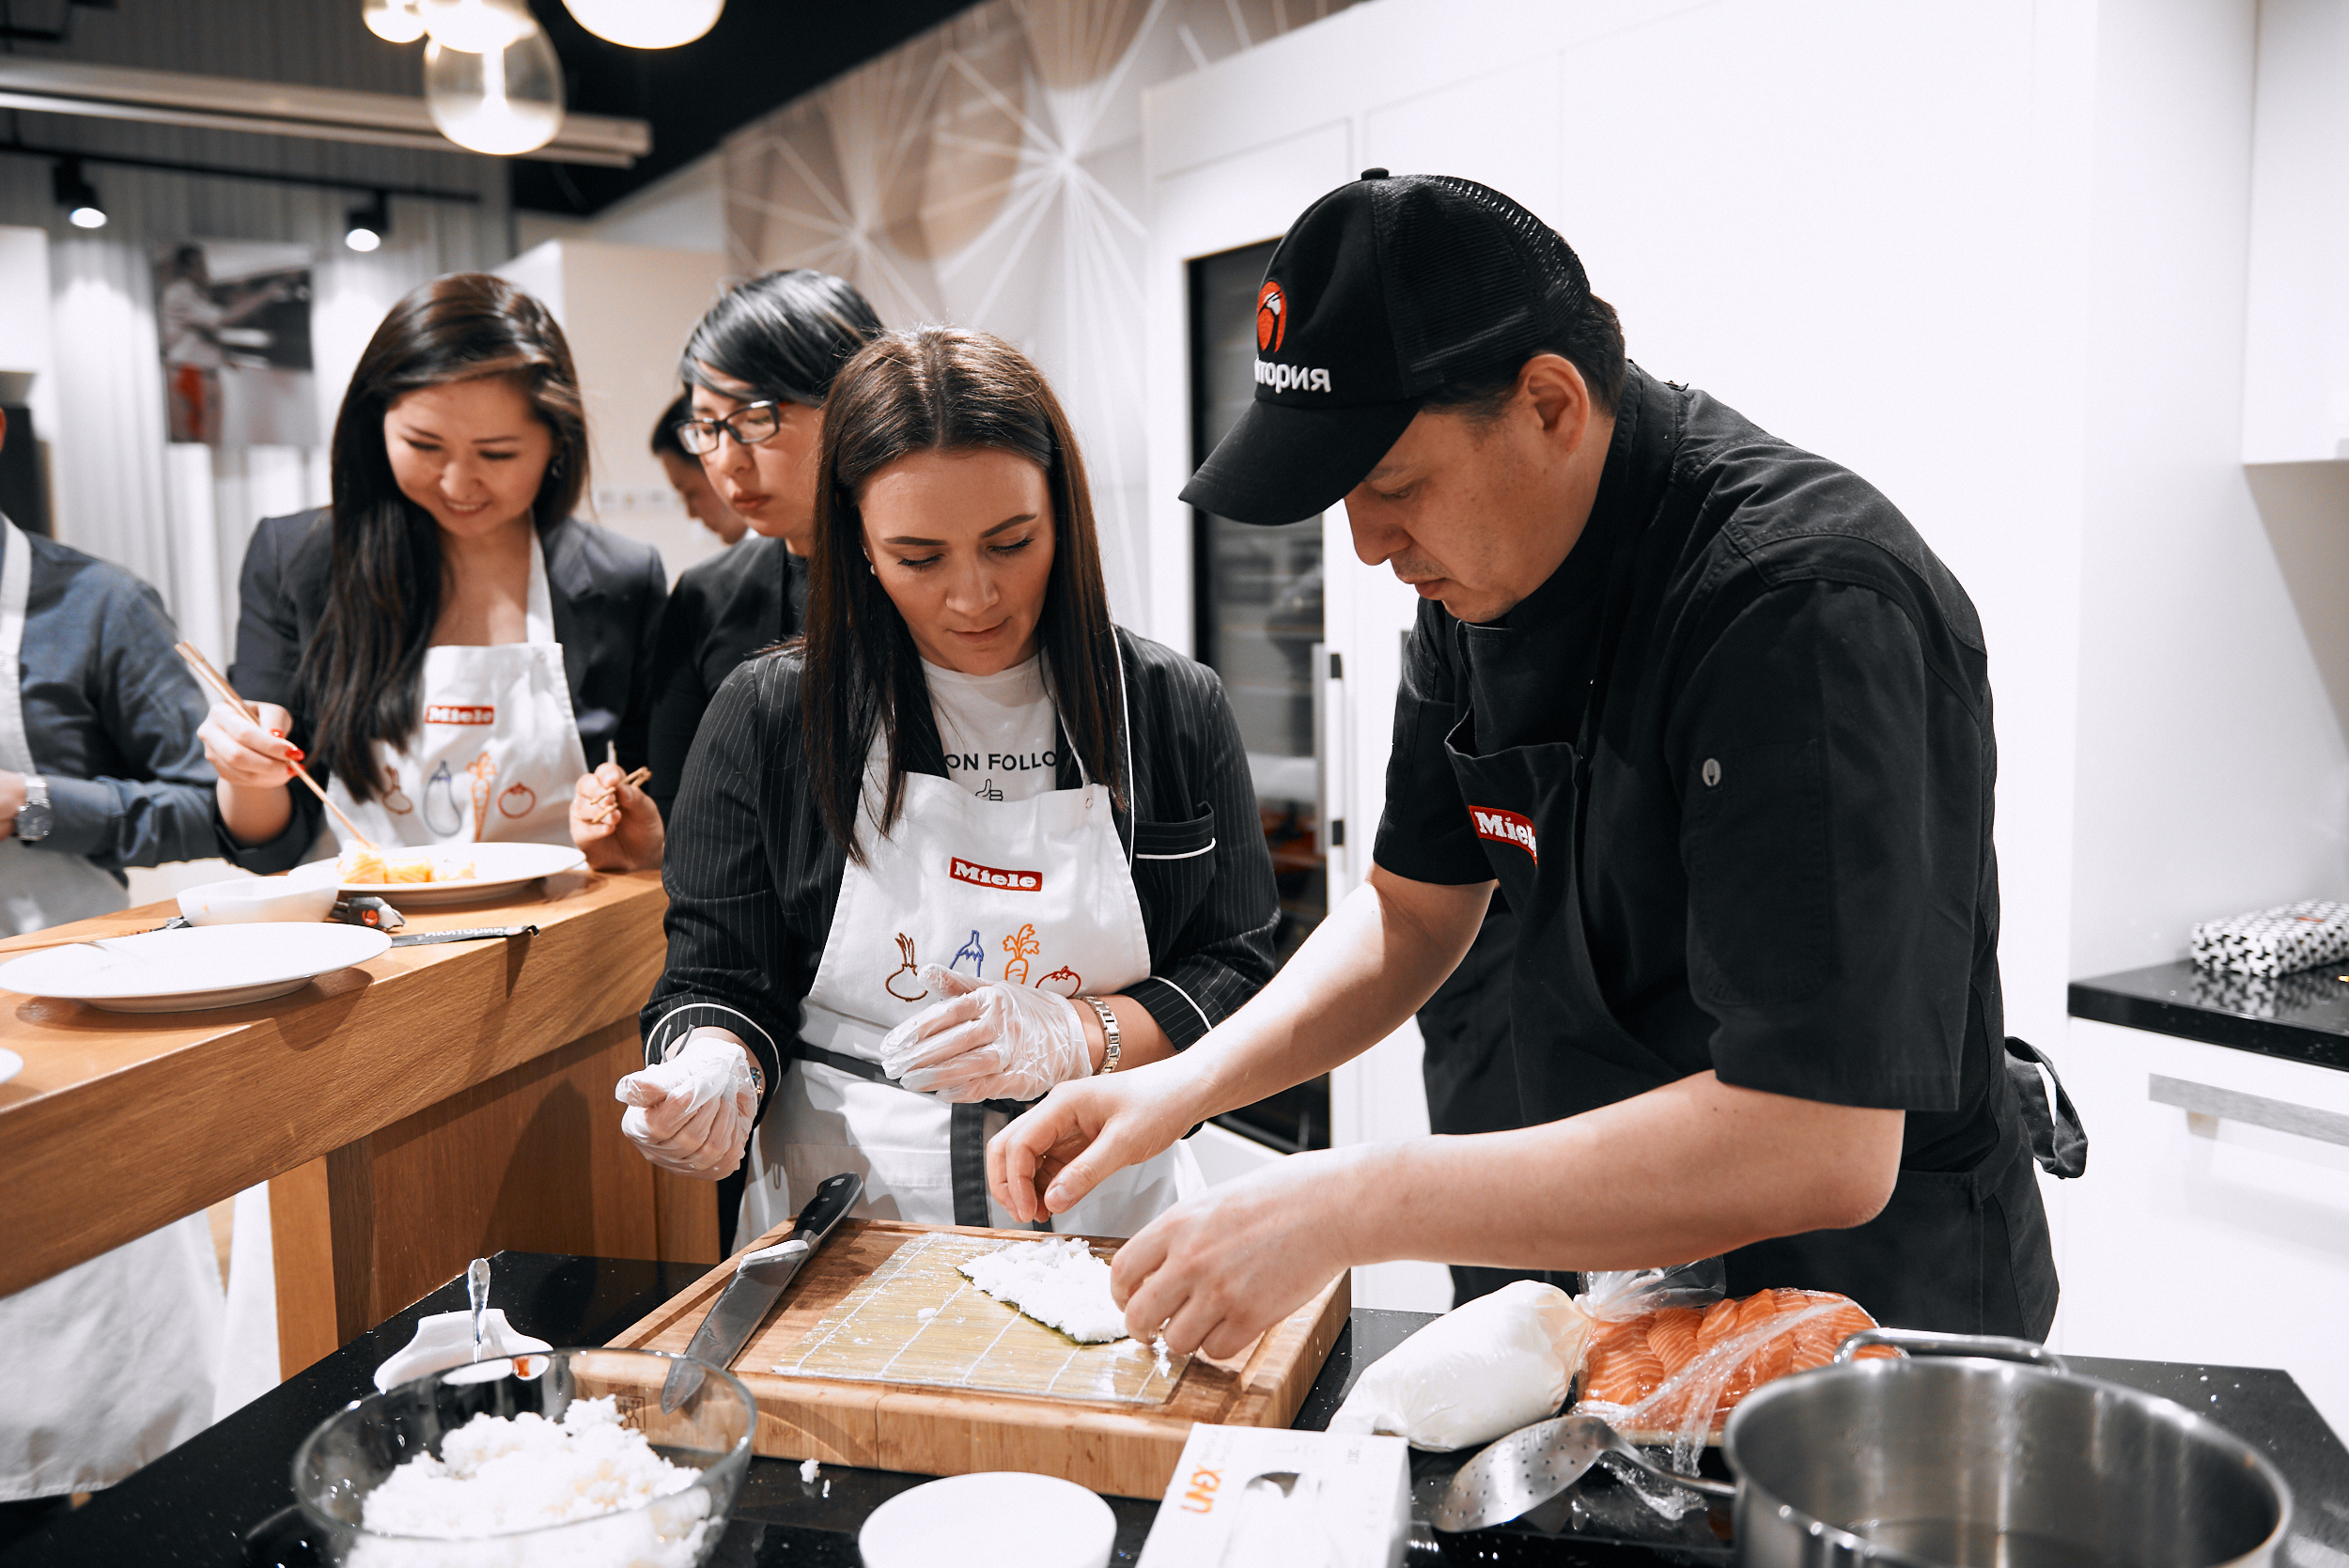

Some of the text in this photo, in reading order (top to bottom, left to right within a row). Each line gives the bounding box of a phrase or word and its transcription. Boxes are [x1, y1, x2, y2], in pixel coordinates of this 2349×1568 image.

[428, 706, 493, 722] Miele
[944, 753, 979, 770] ON
[1473, 811, 1537, 858] Miel
[954, 861, 1037, 888] Miele
